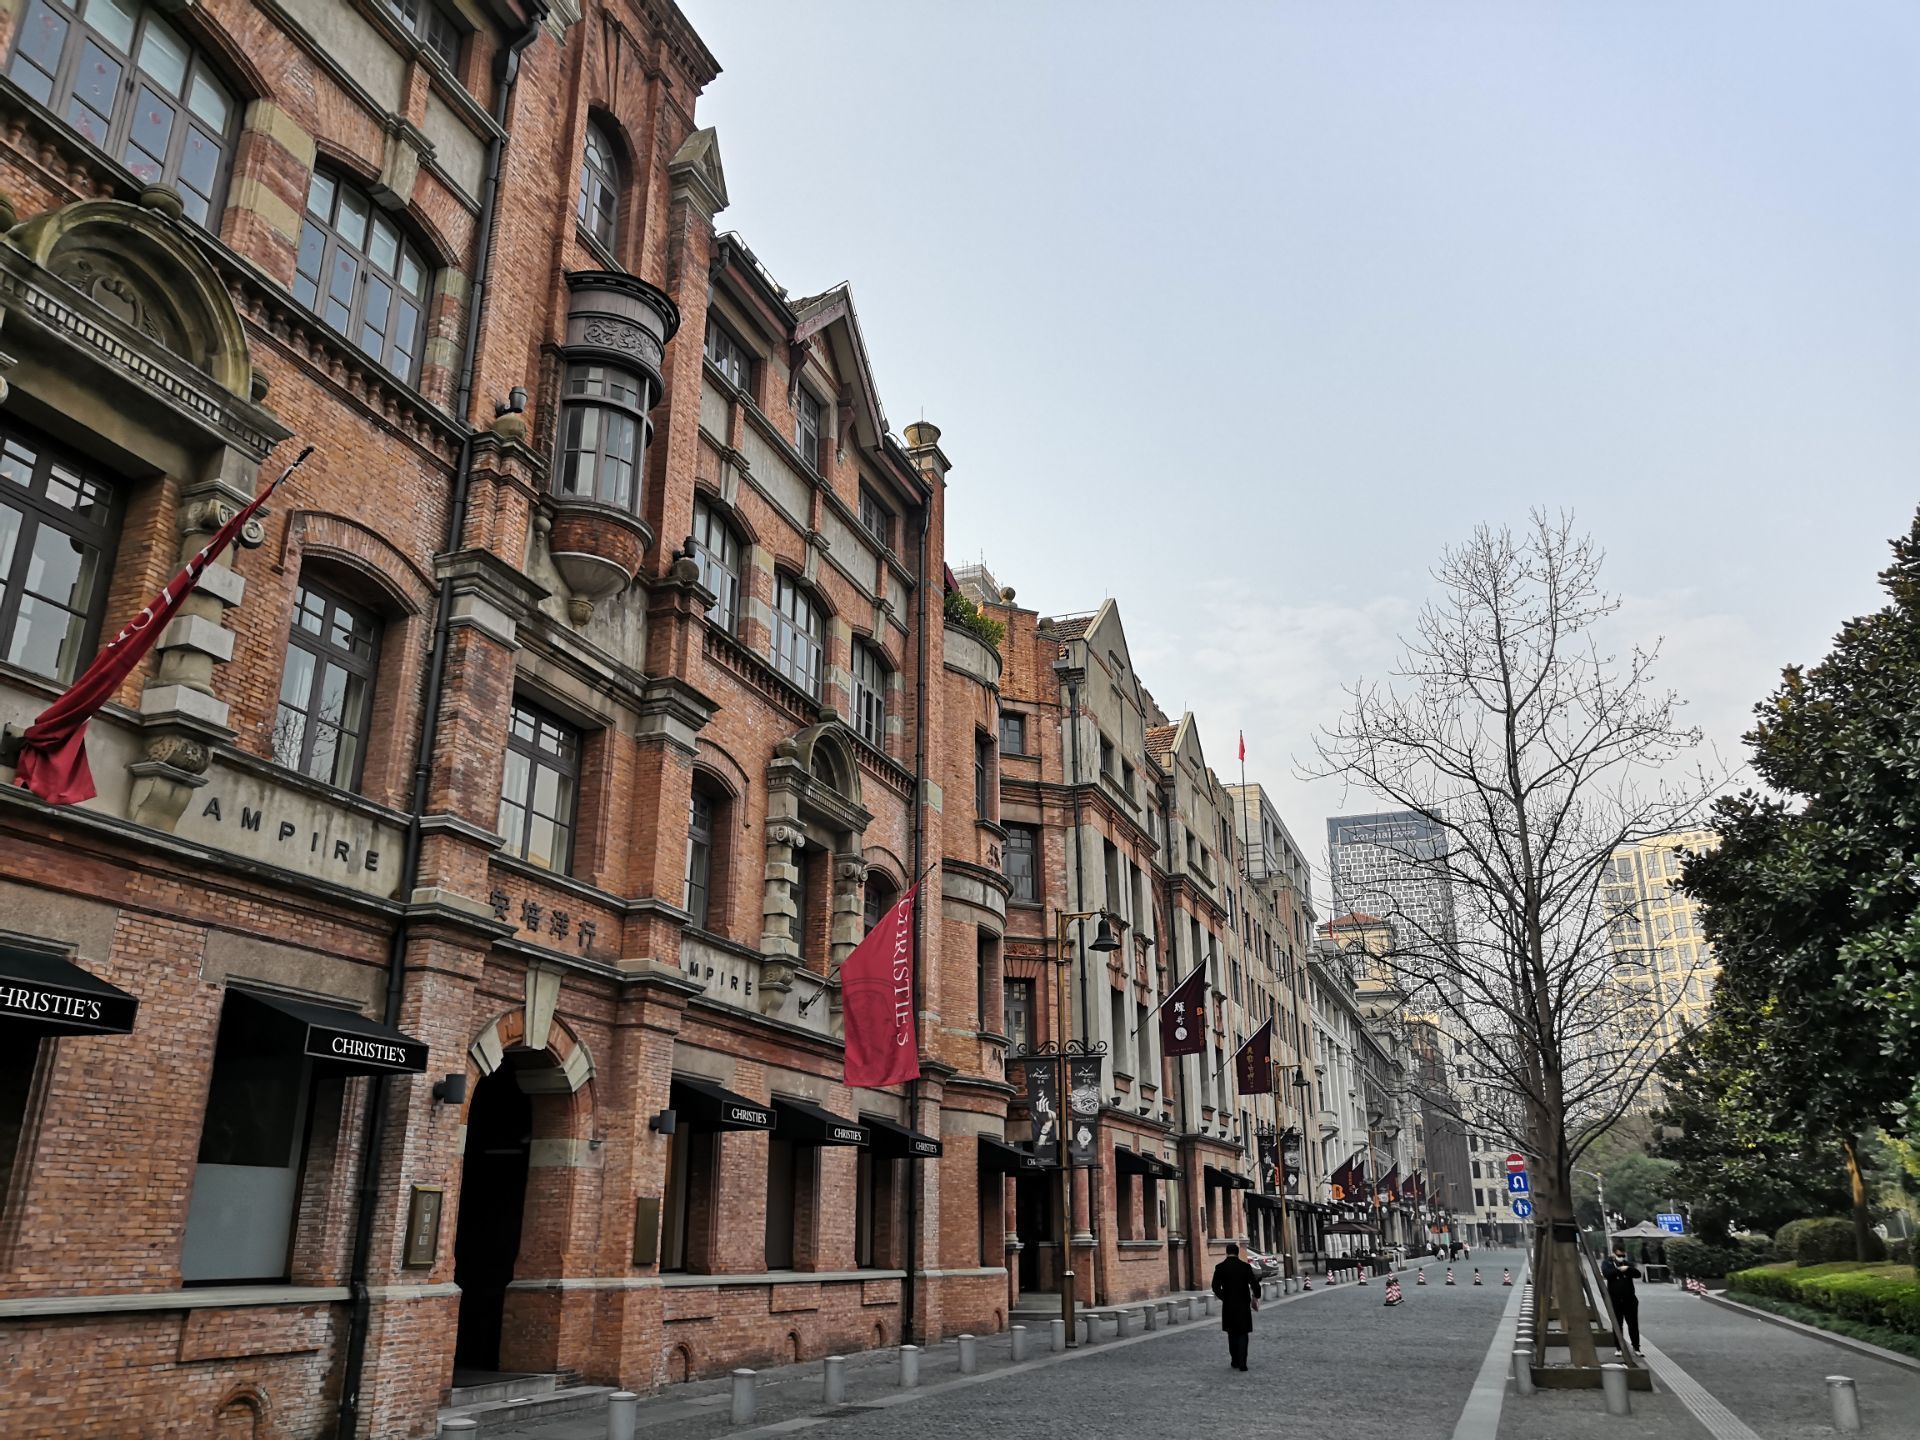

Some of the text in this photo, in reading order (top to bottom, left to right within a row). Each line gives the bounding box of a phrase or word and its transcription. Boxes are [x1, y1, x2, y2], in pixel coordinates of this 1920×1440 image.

[202, 797, 380, 872] AMPIRE
[490, 886, 597, 951] 安培洋行
[679, 960, 753, 996] MPIRE
[332, 1037, 406, 1063] CHRISTIE'S
[731, 1107, 767, 1124] CHRISTIE'S
[834, 1127, 862, 1142] CHRISTIE'S
